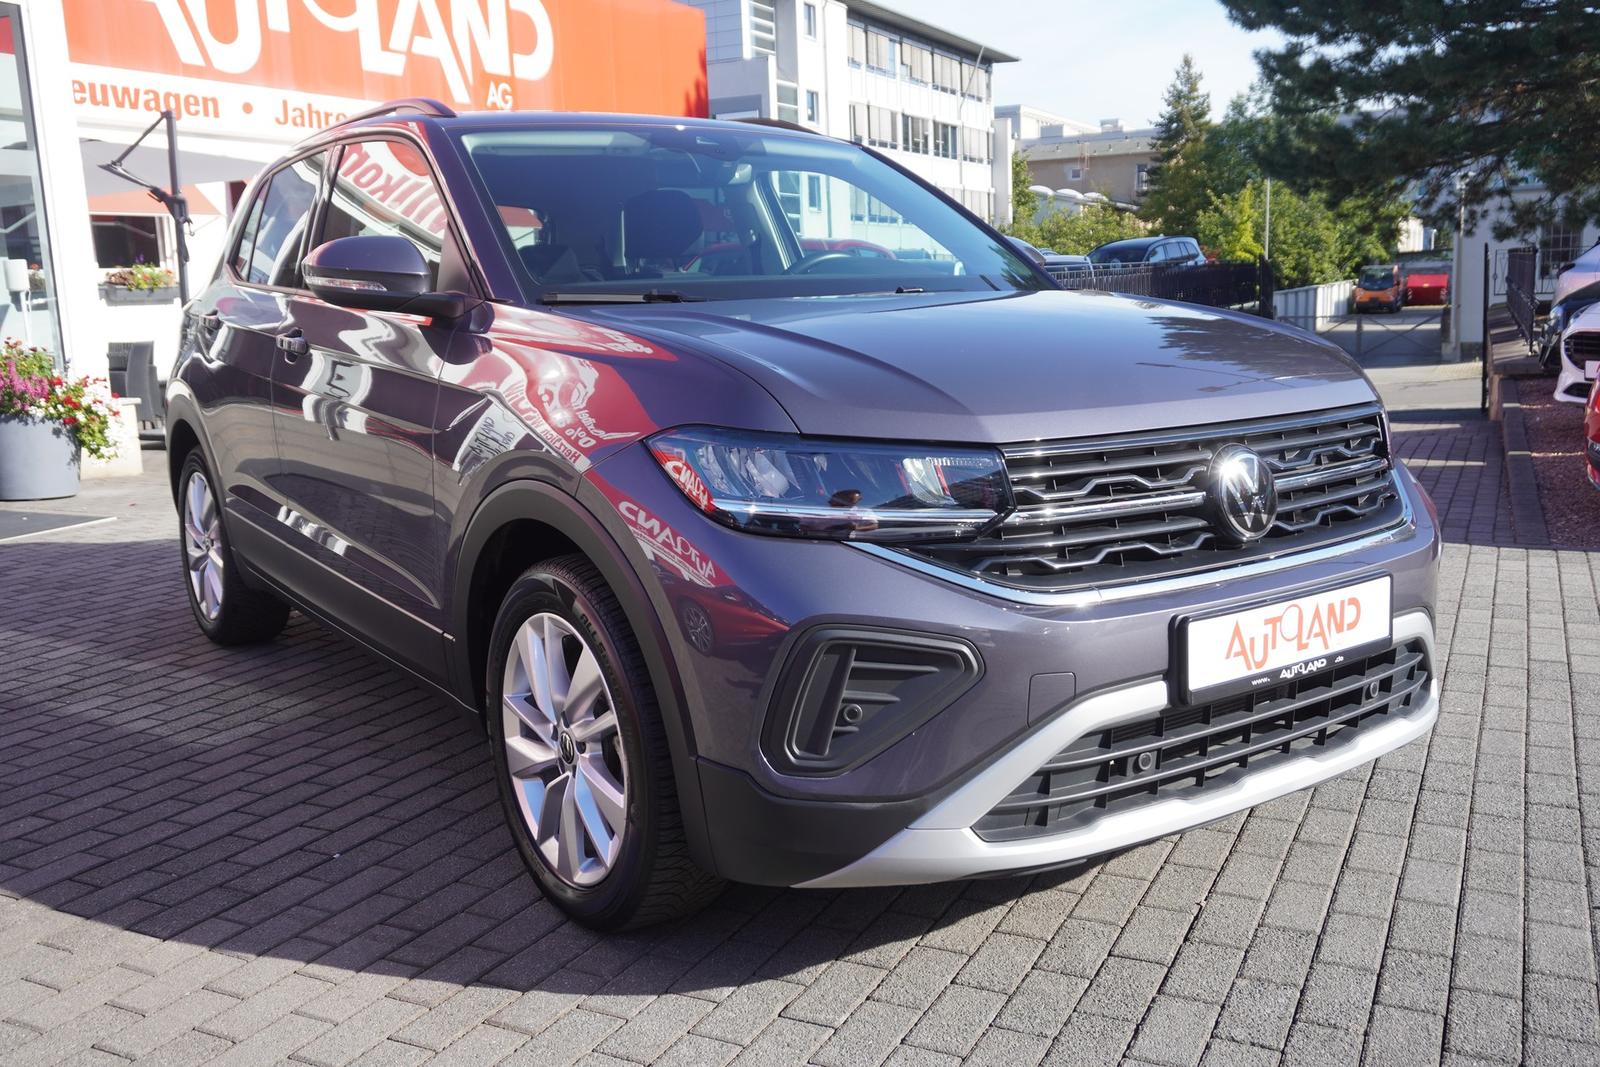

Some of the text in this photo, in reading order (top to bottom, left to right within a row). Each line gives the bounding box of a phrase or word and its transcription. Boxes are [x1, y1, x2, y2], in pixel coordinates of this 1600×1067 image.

[72, 79, 220, 120] euwagen
[486, 80, 513, 109] AG
[1225, 597, 1361, 671] AUTOLAND
[1280, 658, 1327, 679] AUTOLAND
